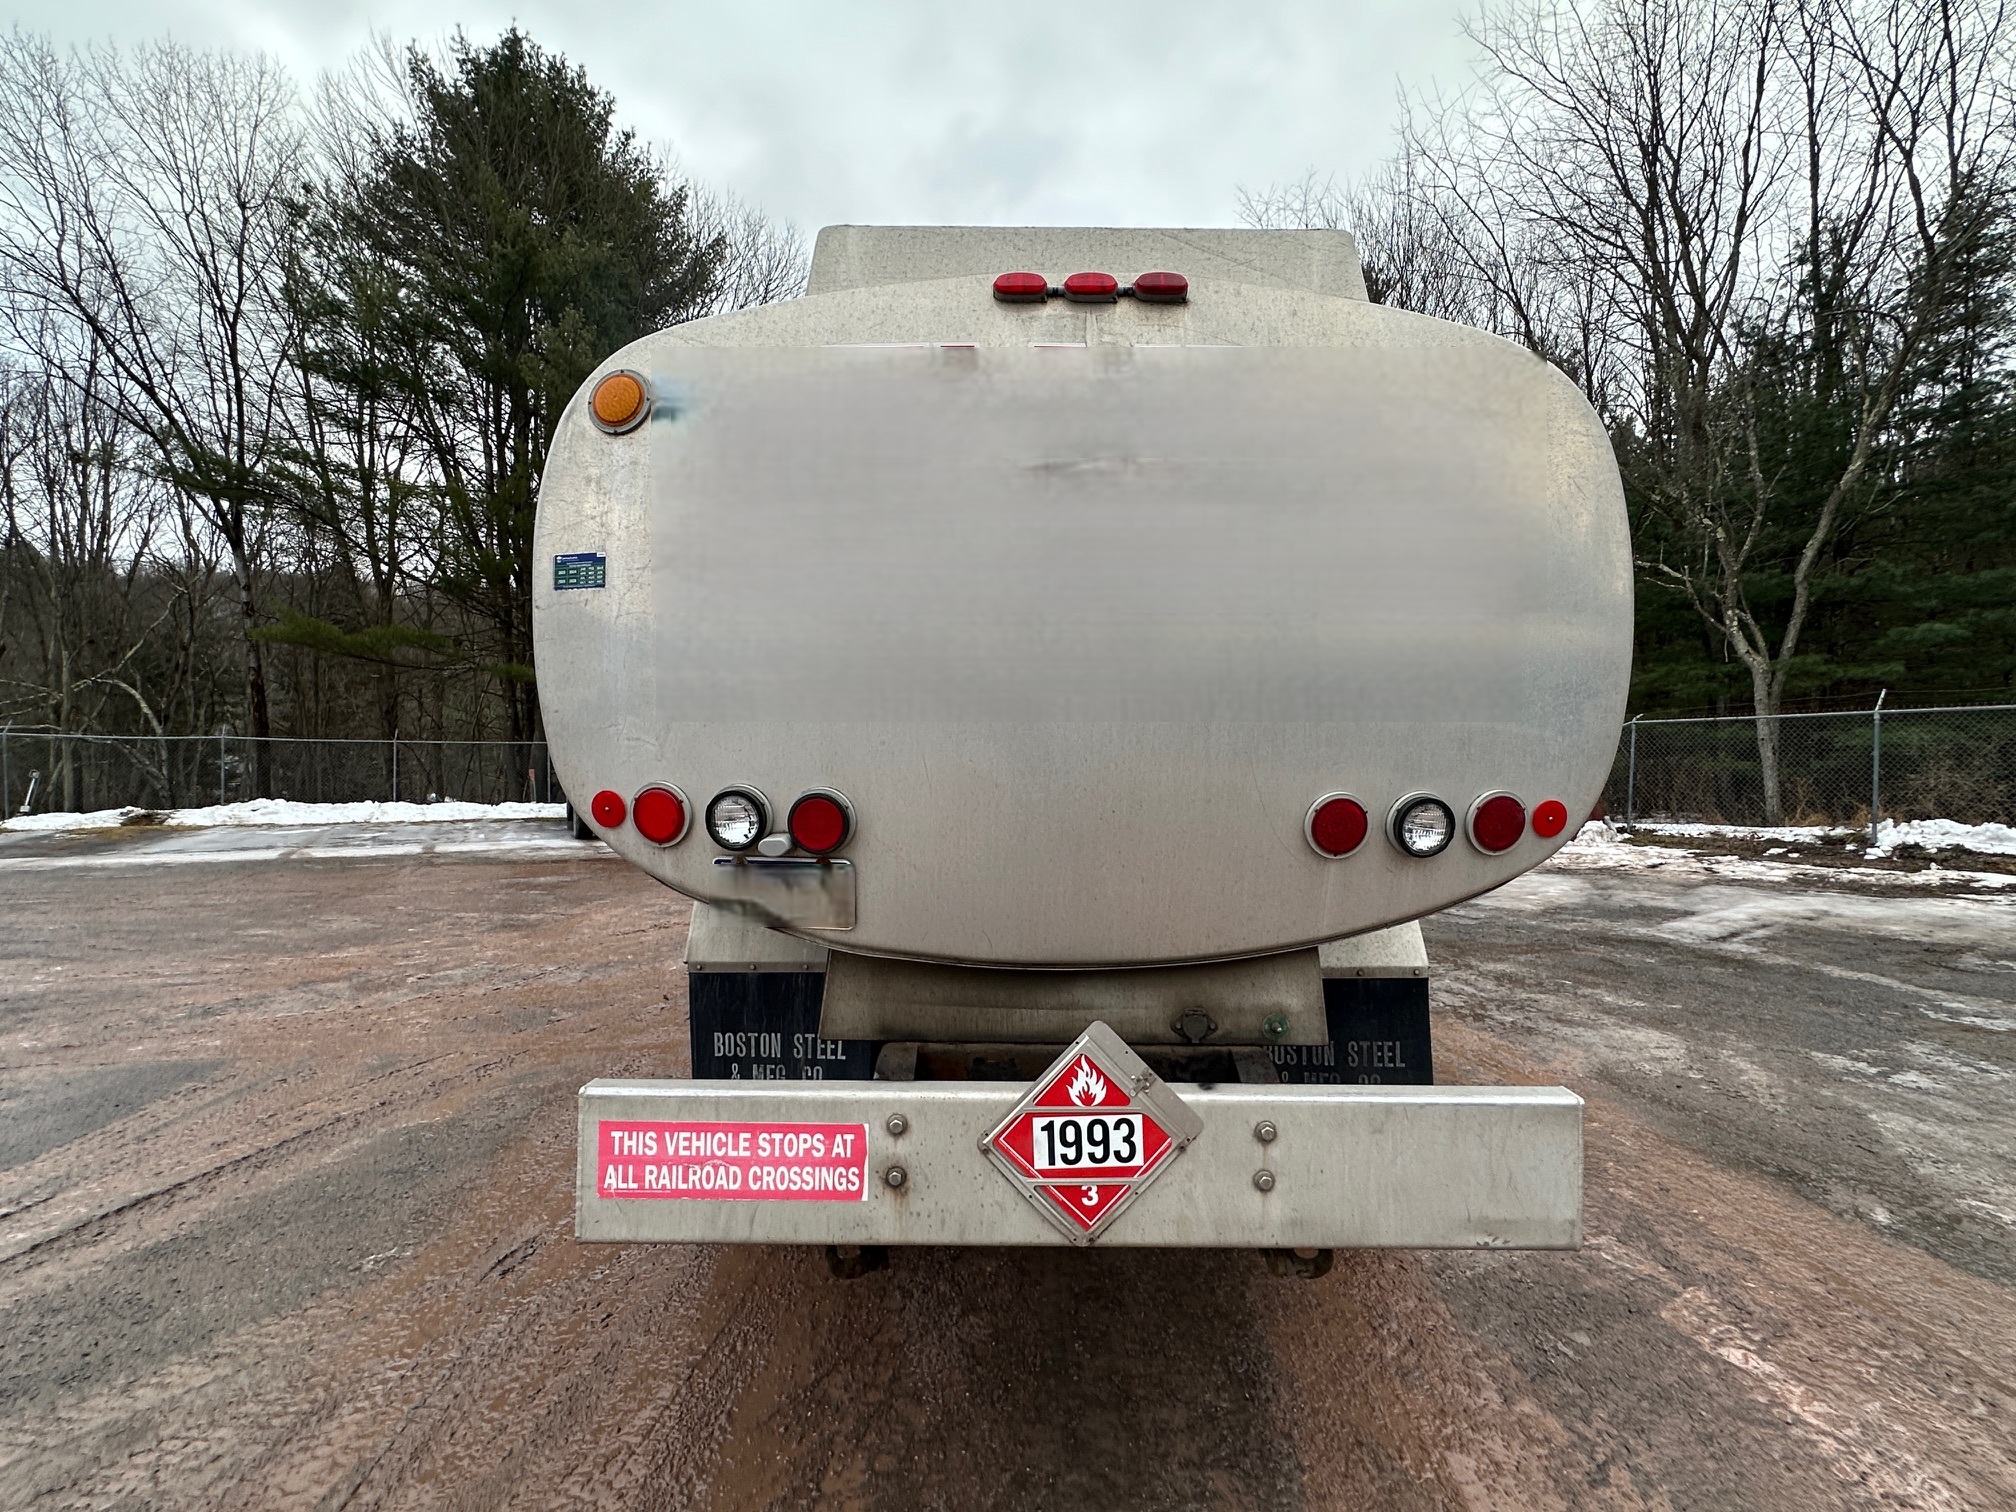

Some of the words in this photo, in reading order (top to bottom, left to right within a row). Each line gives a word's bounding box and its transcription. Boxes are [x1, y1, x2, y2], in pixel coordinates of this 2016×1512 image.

[713, 1032, 781, 1058] BOSTON
[793, 1033, 846, 1060] STEEL
[1347, 1040, 1406, 1068] STEEL
[610, 1130, 658, 1156] THIS
[664, 1131, 751, 1157] VEHICLE
[757, 1132, 825, 1158] STOPS
[831, 1133, 855, 1158] AT
[1040, 1117, 1137, 1167] 1993
[603, 1164, 639, 1189] ALL
[644, 1164, 742, 1191] RAILROAD
[748, 1165, 860, 1192] CROSSINGS
[1081, 1185, 1099, 1206] 3
